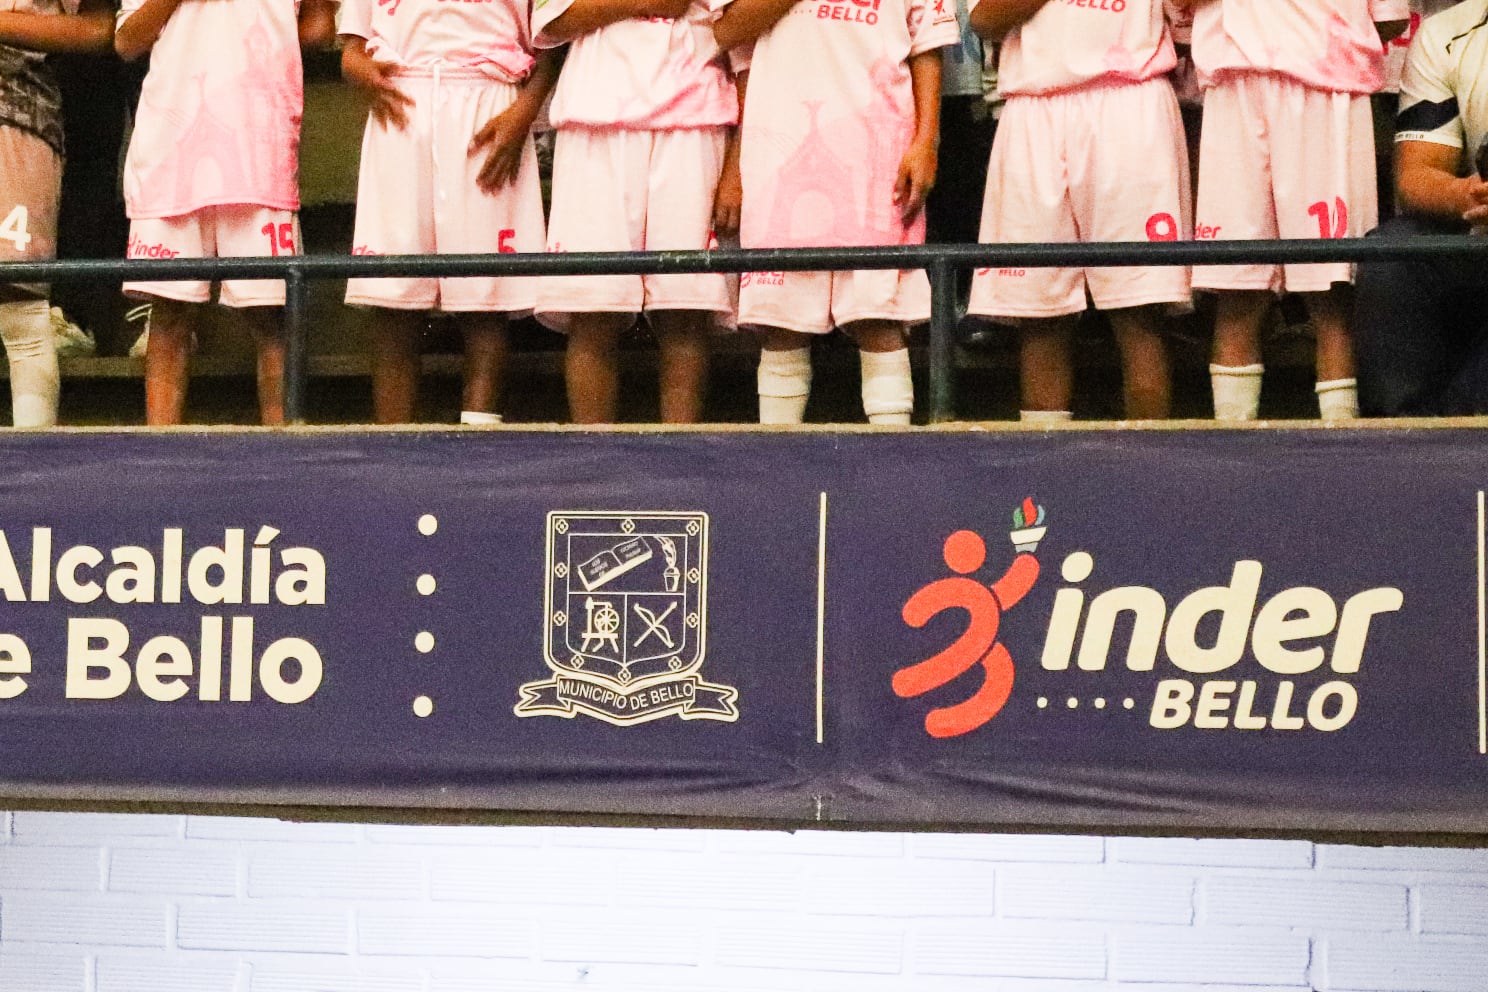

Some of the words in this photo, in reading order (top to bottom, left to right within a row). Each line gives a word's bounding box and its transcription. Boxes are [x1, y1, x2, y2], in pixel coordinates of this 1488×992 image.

[817, 4, 879, 26] BELLO
[1041, 551, 1404, 674] inder
[65, 616, 323, 704] Bello
[559, 680, 627, 709] MUNICIPIO
[630, 695, 648, 710] DE
[650, 683, 694, 705] BELLO
[1149, 679, 1358, 732] BELLO
